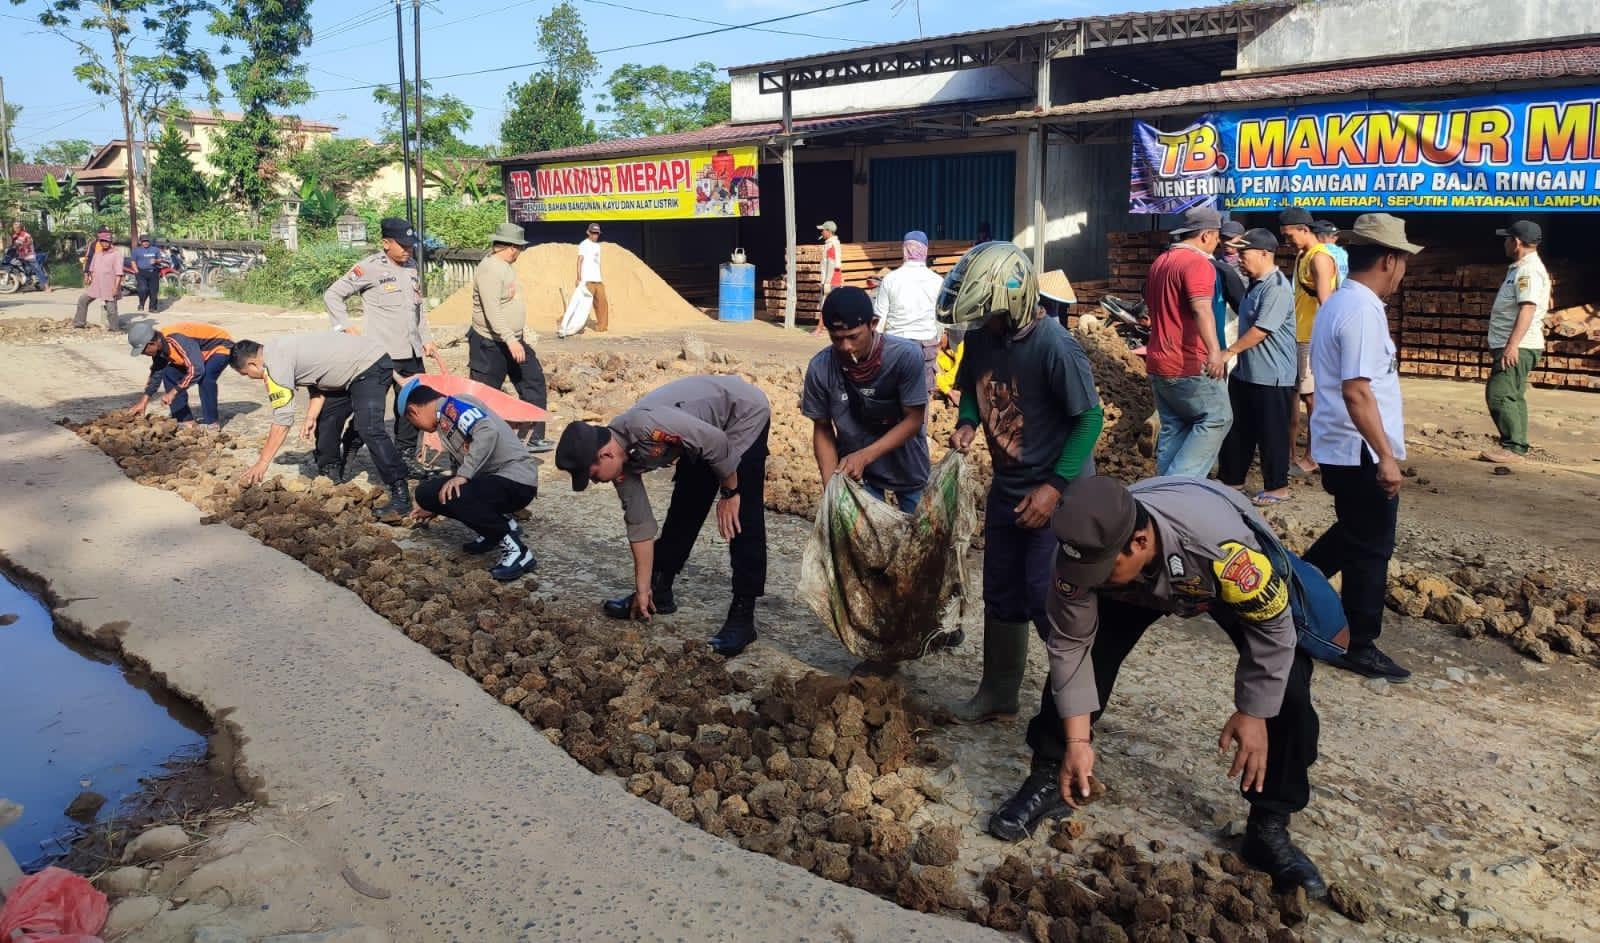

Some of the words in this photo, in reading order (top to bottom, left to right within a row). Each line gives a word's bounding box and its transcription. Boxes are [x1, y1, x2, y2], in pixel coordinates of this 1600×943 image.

[1156, 122, 1229, 177] TB.
[1237, 108, 1513, 170] MAKMUR
[1524, 99, 1600, 165] M
[511, 171, 536, 199] TB.
[536, 165, 613, 197] MAKMUR
[615, 159, 692, 194] MERAPI
[1242, 172, 1367, 194] PEMASANGAN
[1373, 172, 1425, 192] ATAP
[1431, 171, 1488, 191] BAJA
[1495, 169, 1586, 191] RINGAN
[602, 200, 620, 210] KAYU
[621, 199, 635, 210] DAN
[636, 199, 652, 209] ALAT
[653, 197, 679, 209] LISTRIK
[1224, 196, 1271, 208] ALAMAT
[1293, 196, 1326, 207] RAYA
[1329, 195, 1384, 208] MERAPI,
[1387, 195, 1448, 207] SEPUTIH
[1451, 195, 1530, 207] MATARAM
